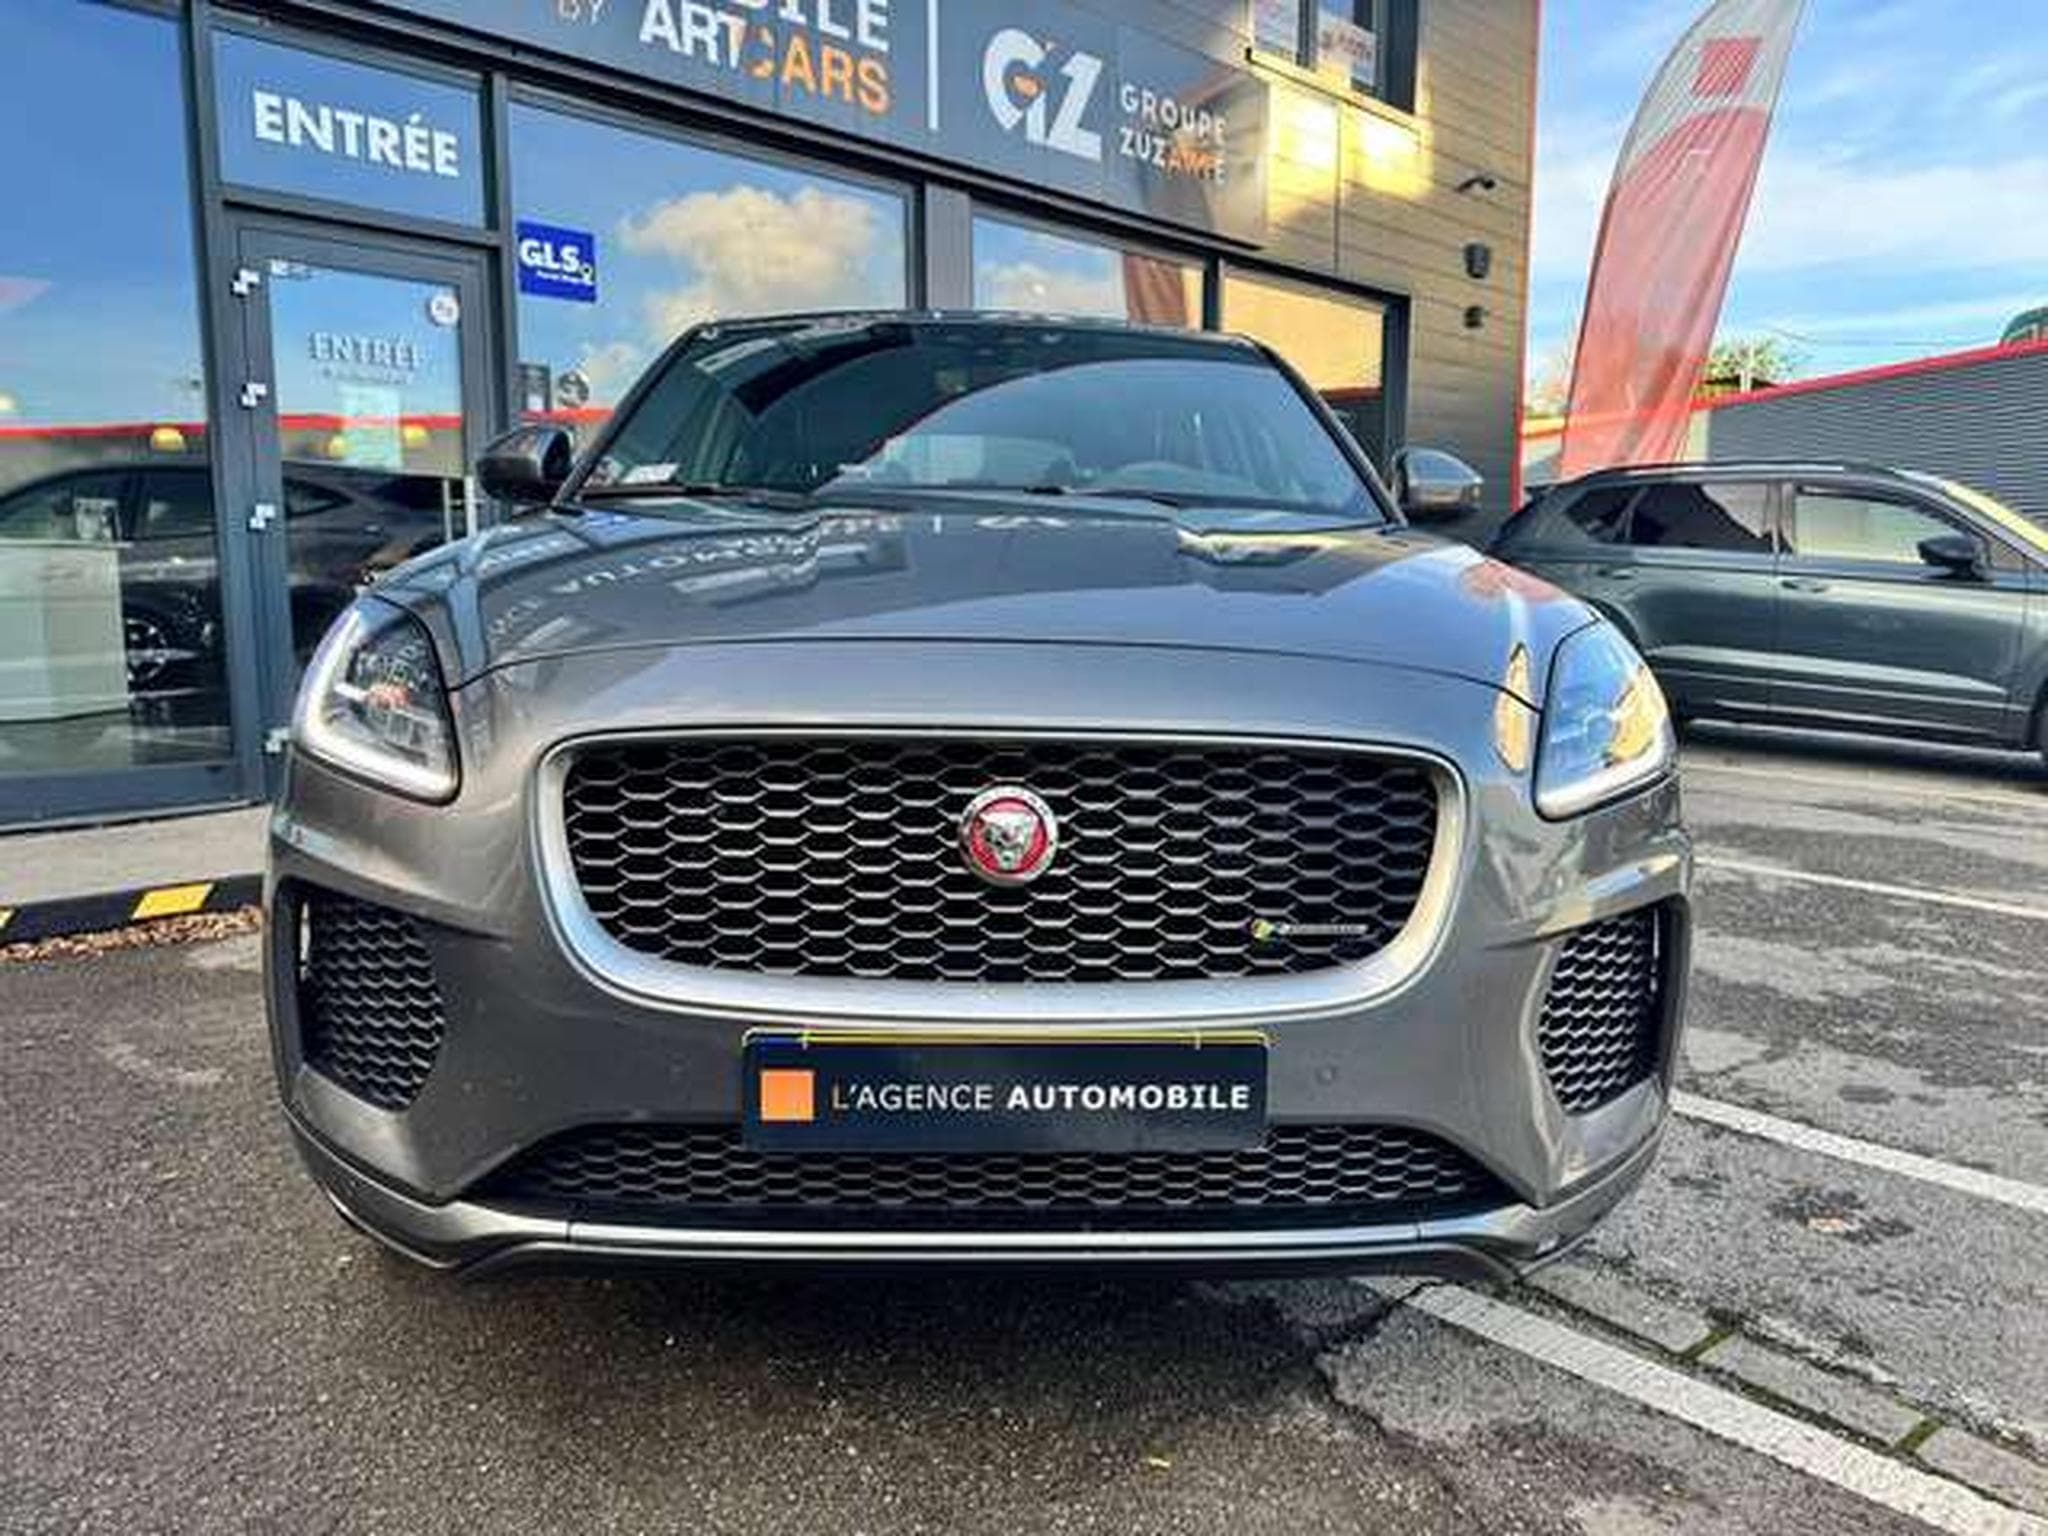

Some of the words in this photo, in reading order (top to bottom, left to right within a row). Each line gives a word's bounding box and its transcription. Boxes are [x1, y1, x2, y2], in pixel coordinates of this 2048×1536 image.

[253, 89, 460, 177] ENTRÉE
[1121, 84, 1226, 145] GROUPE
[520, 238, 580, 272] GLS
[1006, 1084, 1250, 1110] AUTOMOBILE
